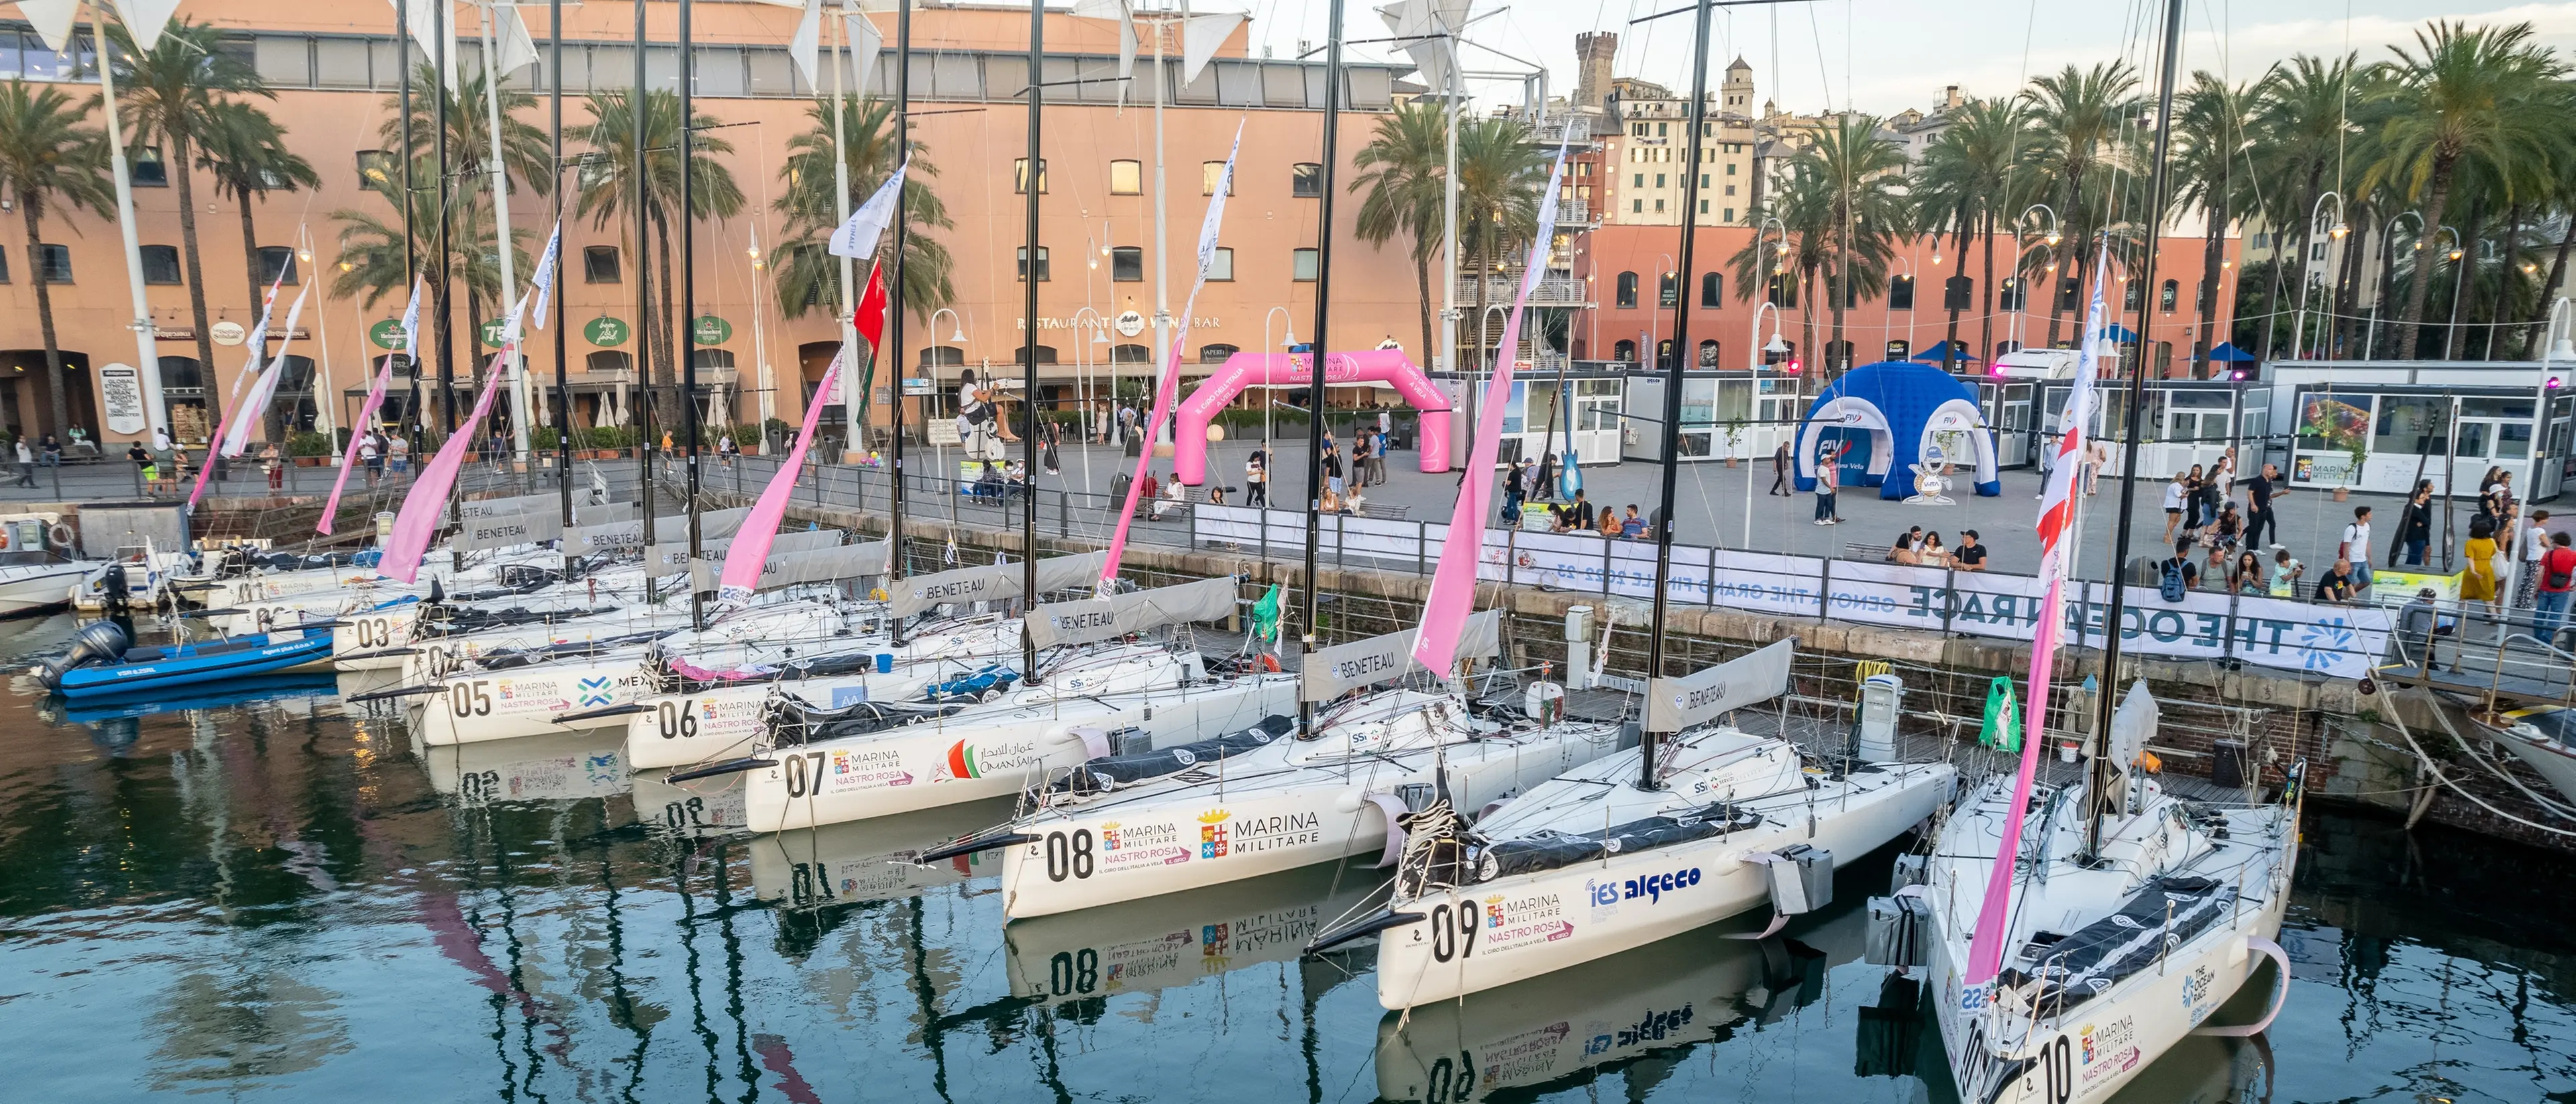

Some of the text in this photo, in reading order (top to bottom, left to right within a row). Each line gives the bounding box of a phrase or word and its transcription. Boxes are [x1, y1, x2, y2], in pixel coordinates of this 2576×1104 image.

[1017, 317, 1110, 330] RSTAURANT
[1194, 317, 1220, 328] BAR
[596, 332, 616, 344] food
[1304, 357, 1342, 365] MINA
[1213, 367, 1244, 397] DELL'ITALIA
[1407, 368, 1419, 381] GIRO
[1418, 377, 1444, 405] DELL'ITALIA
[1220, 388, 1236, 404] VELA
[1413, 385, 1428, 401] VELA
[1845, 413, 1858, 421] FIV
[1818, 439, 1843, 456] FIV
[444, 506, 493, 519] BETEAU
[477, 525, 527, 540] BENETEAU
[592, 533, 645, 546] BENETEAU
[673, 549, 727, 564] BETEAU
[926, 578, 985, 599] BENETEAU
[306, 606, 341, 614] MARINA
[1060, 611, 1114, 630] BENETEAU
[358, 617, 389, 648] 03
[1340, 652, 1395, 679] BENETEAU
[515, 681, 558, 691] MARINA
[515, 690, 559, 698] MILITARE
[453, 681, 490, 717] 05
[500, 698, 560, 709] NASTRO ROSA
[1688, 681, 1726, 710] BENETEAU
[720, 700, 761, 711] MARINA
[659, 700, 697, 739] 06
[704, 719, 740, 729] NASTRO
[851, 750, 900, 764] MARINA
[785, 752, 825, 798] 07
[853, 761, 900, 772] MILITARE
[980, 760, 1014, 773] OMAN
[836, 770, 902, 786] NASTRO ROSA
[1124, 823, 1176, 839] MARINA
[1236, 811, 1319, 838] MARINA
[1124, 835, 1177, 848] MILITARE
[1235, 832, 1319, 854] MILITARE
[1046, 828, 1093, 883] 08
[1105, 846, 1178, 864] NASTRO ROSA
[1118, 863, 1145, 871] DELL'ITALIA
[1625, 867, 1701, 906] algeco
[1507, 894, 1560, 914] MARINA
[1508, 908, 1561, 925] MILITARE
[1432, 899, 1479, 963] 09
[1489, 919, 1561, 944] NASTRO ROSA
[1487, 946, 1500, 955] GIRO
[1501, 942, 1529, 952] DELL'ITALIA
[2196, 964, 2205, 978] THE
[2194, 969, 2215, 991] OCEAN
[2193, 987, 2207, 1004] RACE
[2096, 1015, 2133, 1045] MARINA
[2096, 1030, 2133, 1058] MILITARE
[2039, 1035, 2072, 1104] 10
[2082, 1046, 2133, 1084] NASTRO ROSA
